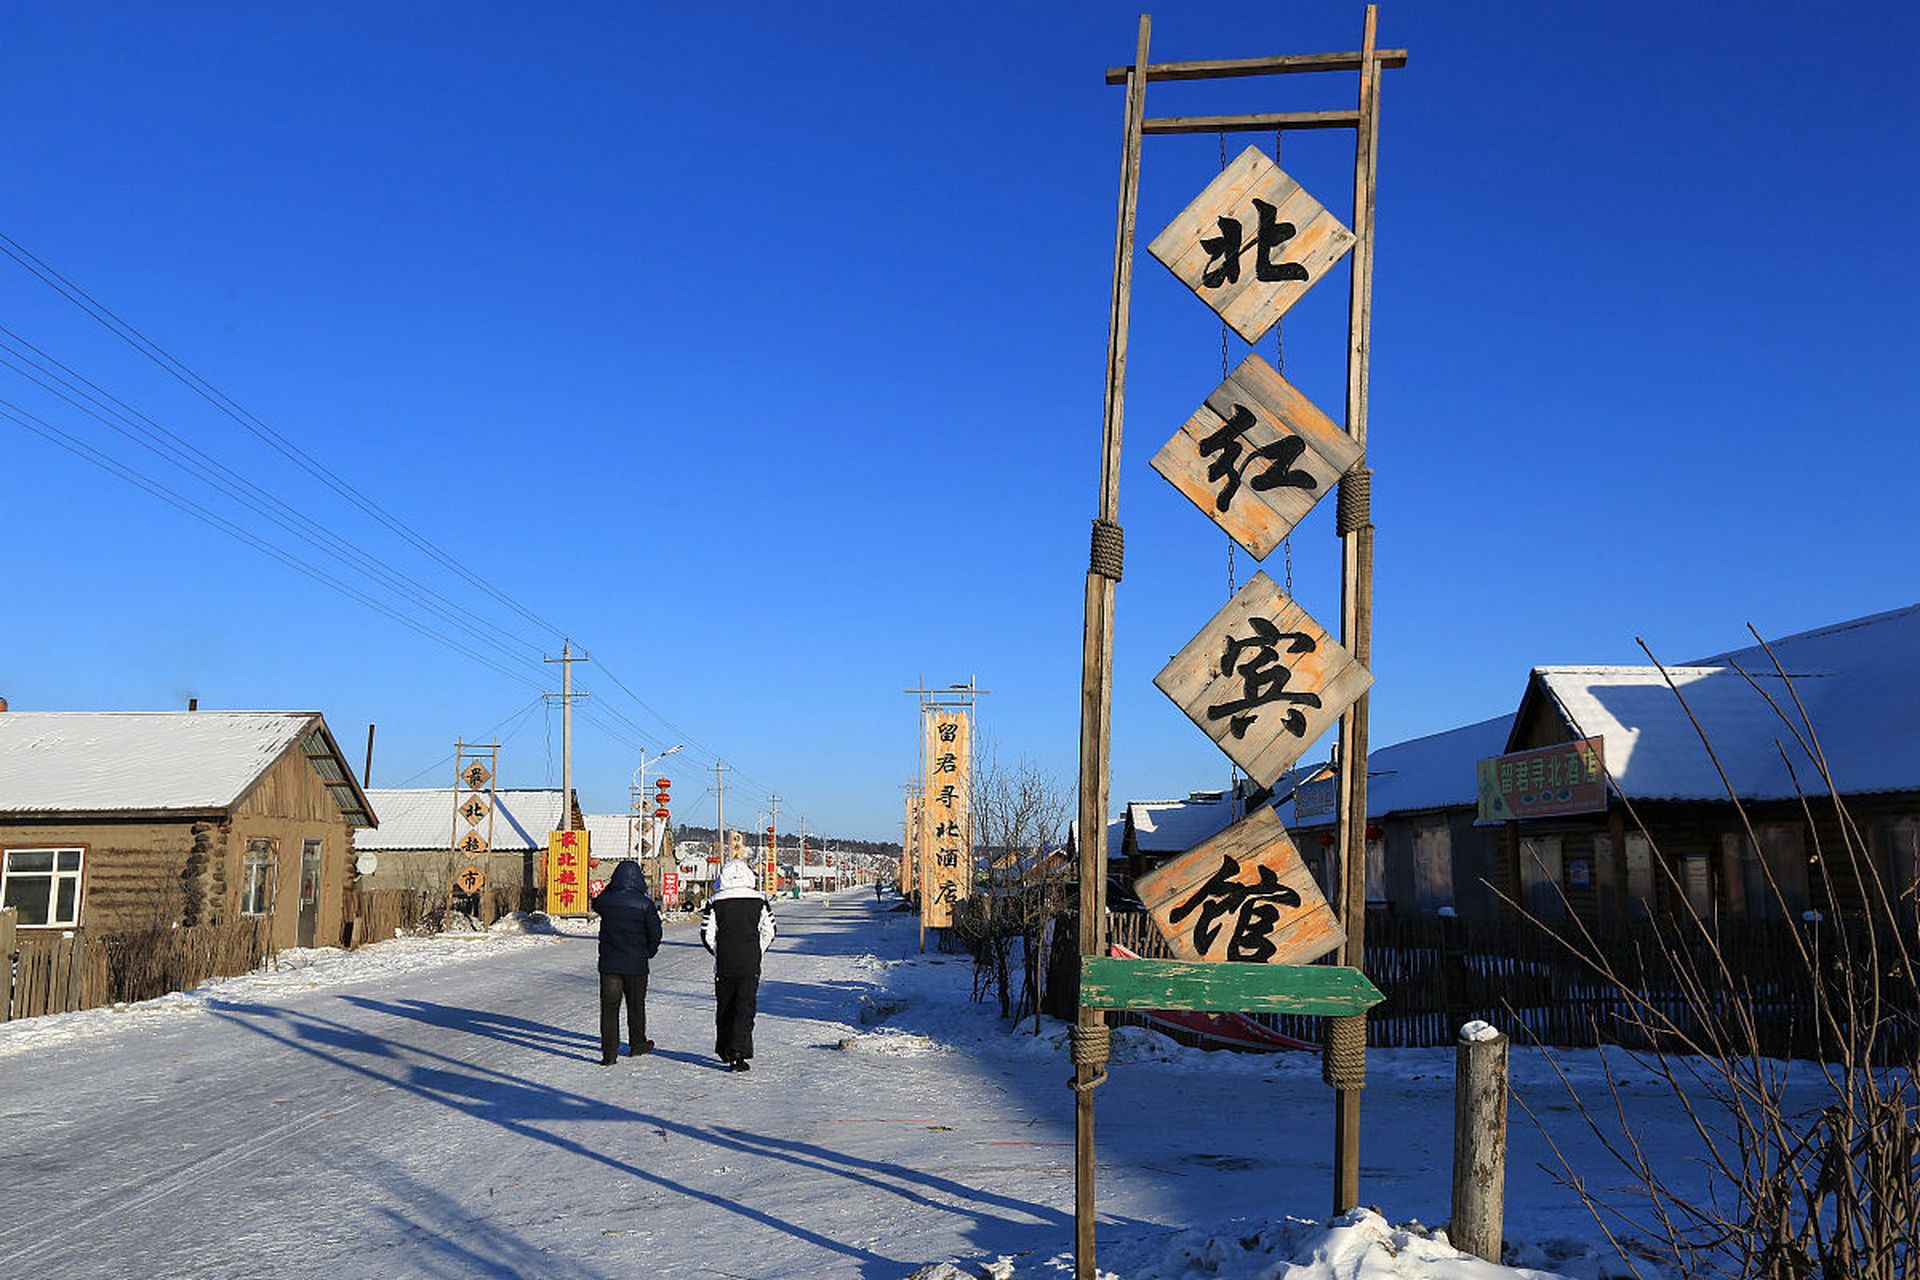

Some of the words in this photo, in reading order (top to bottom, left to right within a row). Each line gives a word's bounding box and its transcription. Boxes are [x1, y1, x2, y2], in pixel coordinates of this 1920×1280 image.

[1169, 198, 1323, 963] 北红宾馆
[461, 768, 484, 891] 最北超市
[555, 831, 578, 908] 最北超市
[933, 722, 960, 905] 留君寻北酒店
